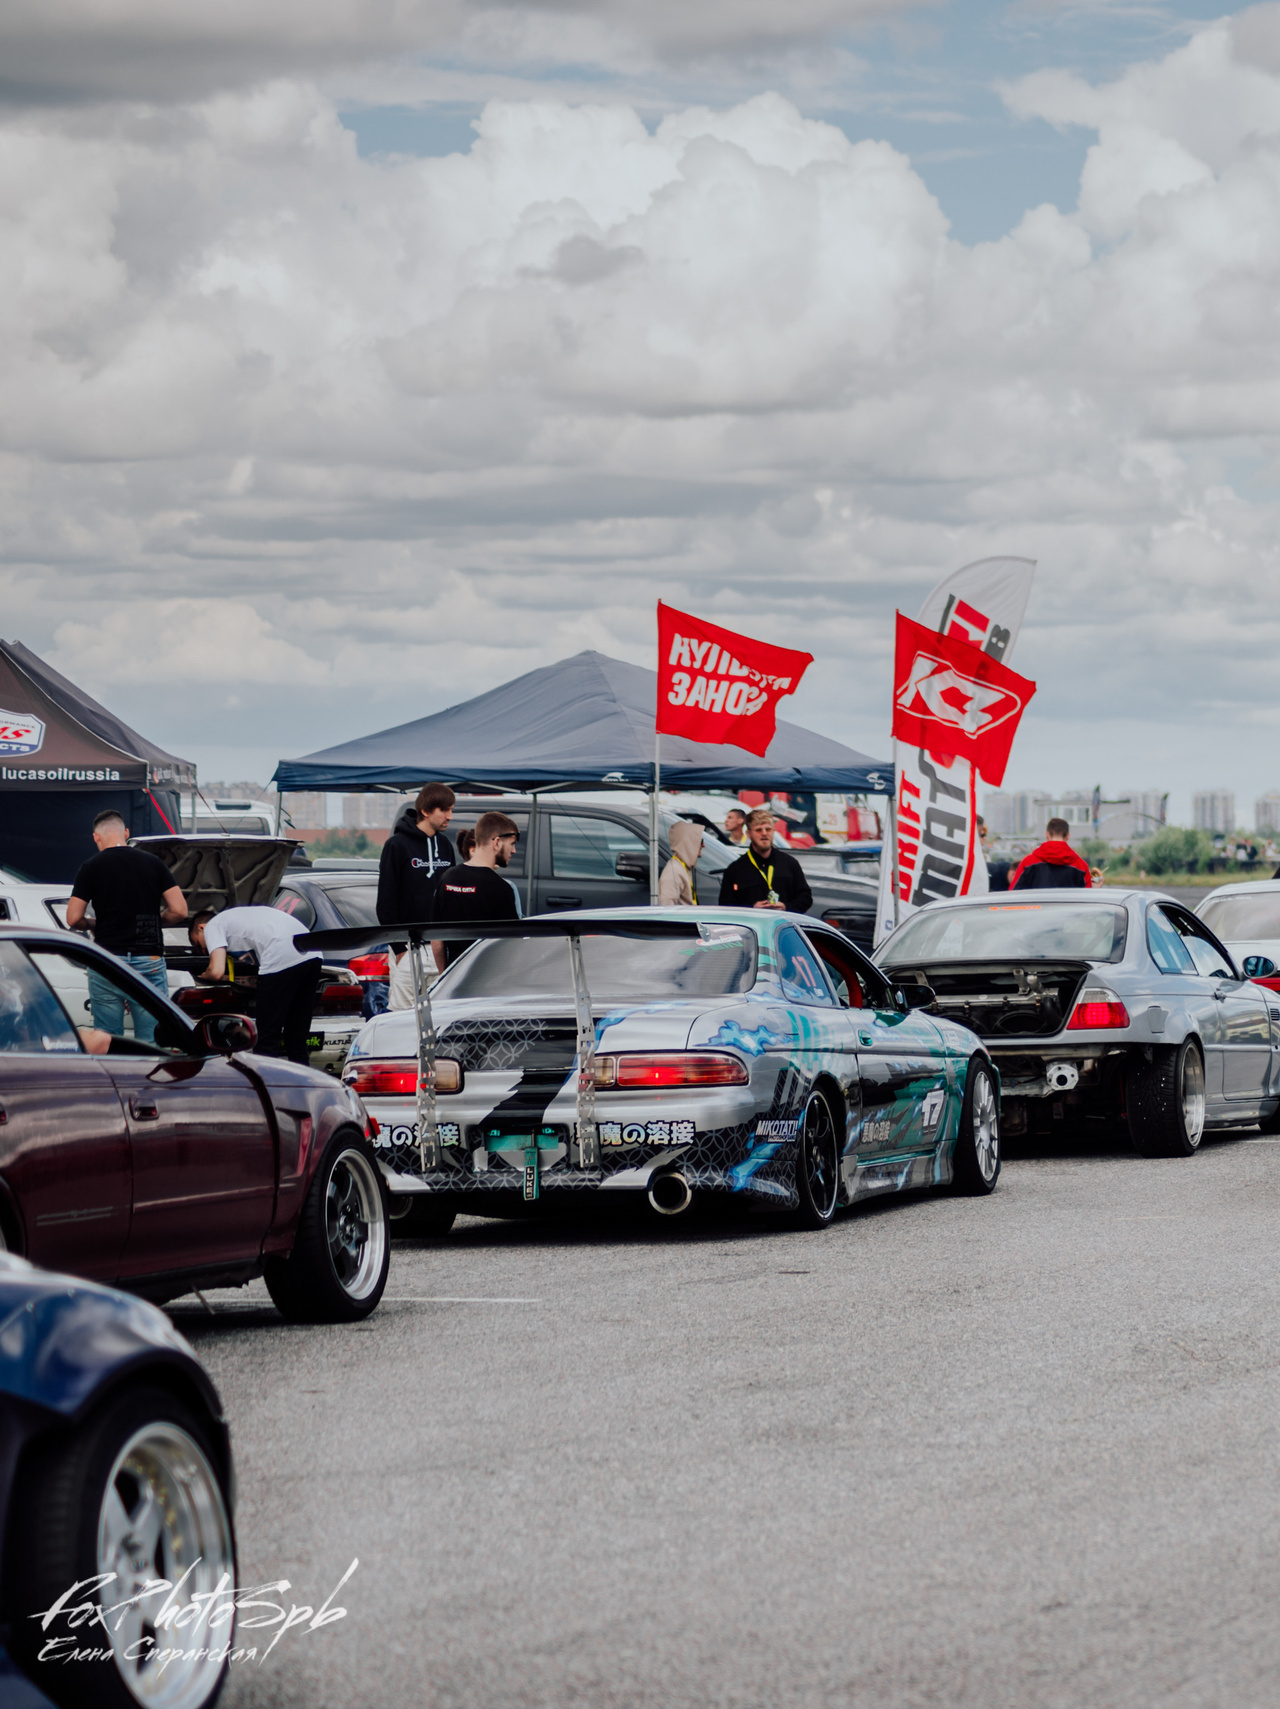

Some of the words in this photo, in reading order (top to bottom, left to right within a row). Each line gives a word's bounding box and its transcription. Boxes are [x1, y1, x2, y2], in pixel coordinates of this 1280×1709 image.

[2, 766, 121, 781] lucasoilrussia
[791, 956, 817, 987] 17
[921, 1090, 945, 1127] 17
[576, 1121, 695, 1146] 魔の溶接
